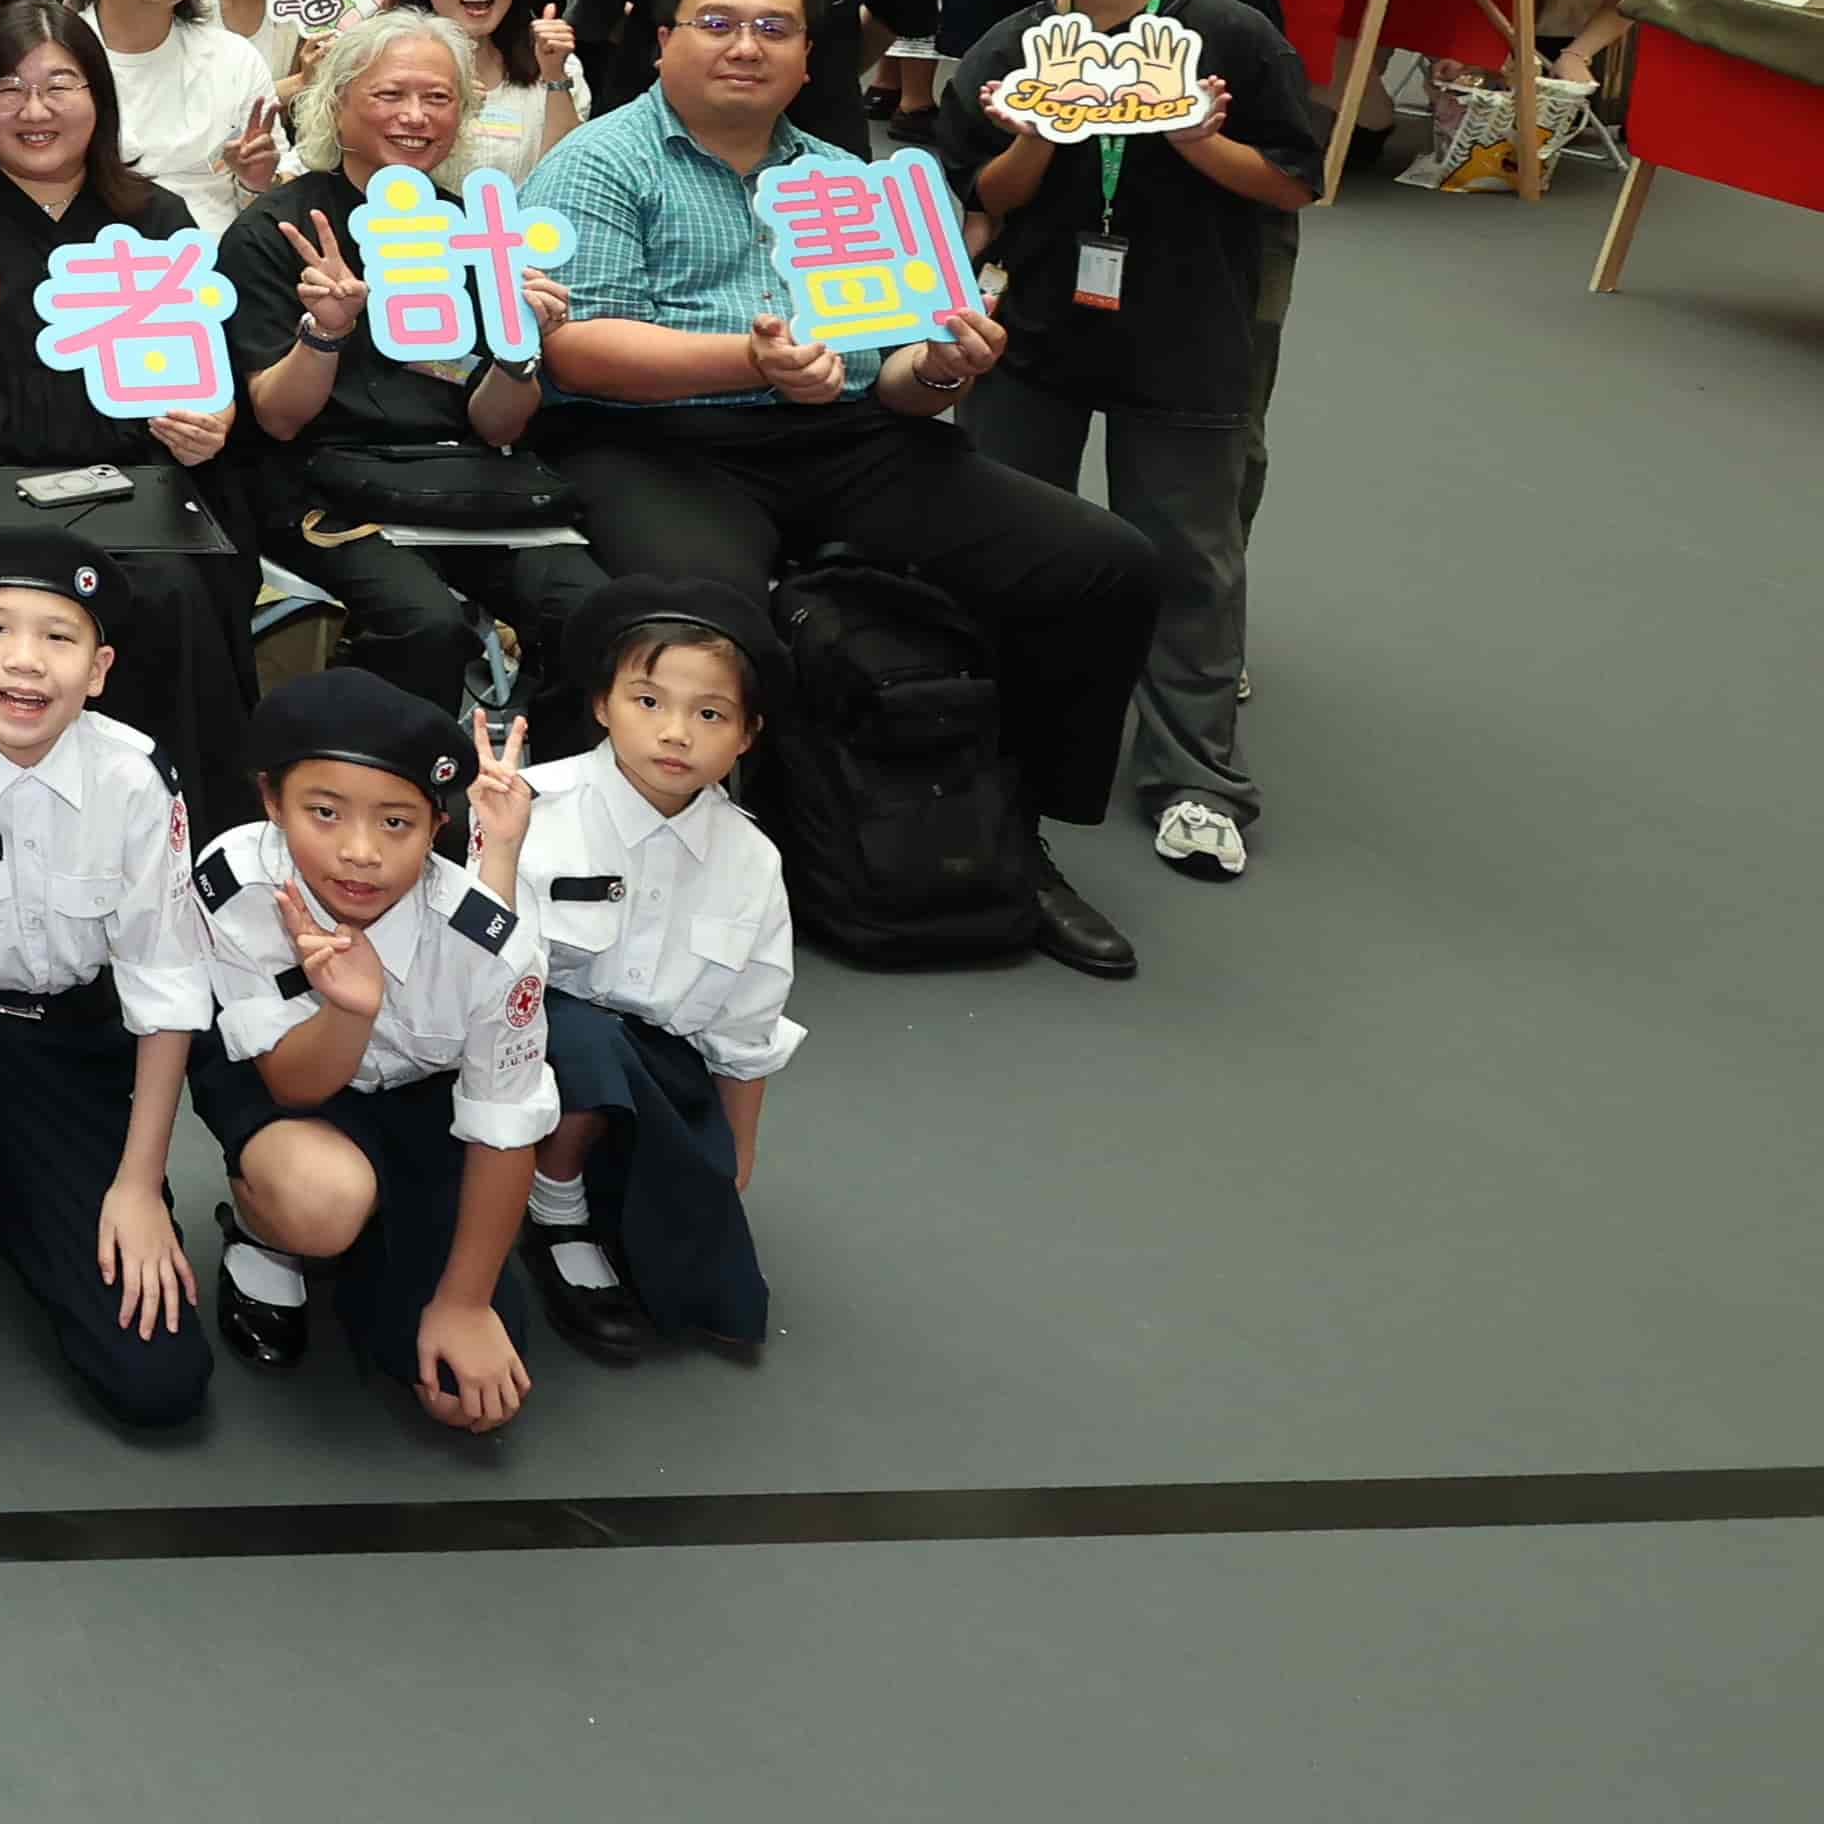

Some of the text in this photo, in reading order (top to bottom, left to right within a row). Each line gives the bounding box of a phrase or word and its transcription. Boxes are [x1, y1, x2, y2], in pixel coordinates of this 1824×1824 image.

[1005, 78, 1198, 133] Together
[50, 239, 223, 399] 者
[364, 180, 560, 354] 計
[772, 164, 968, 338] 劃
[485, 912, 507, 939] RCY
